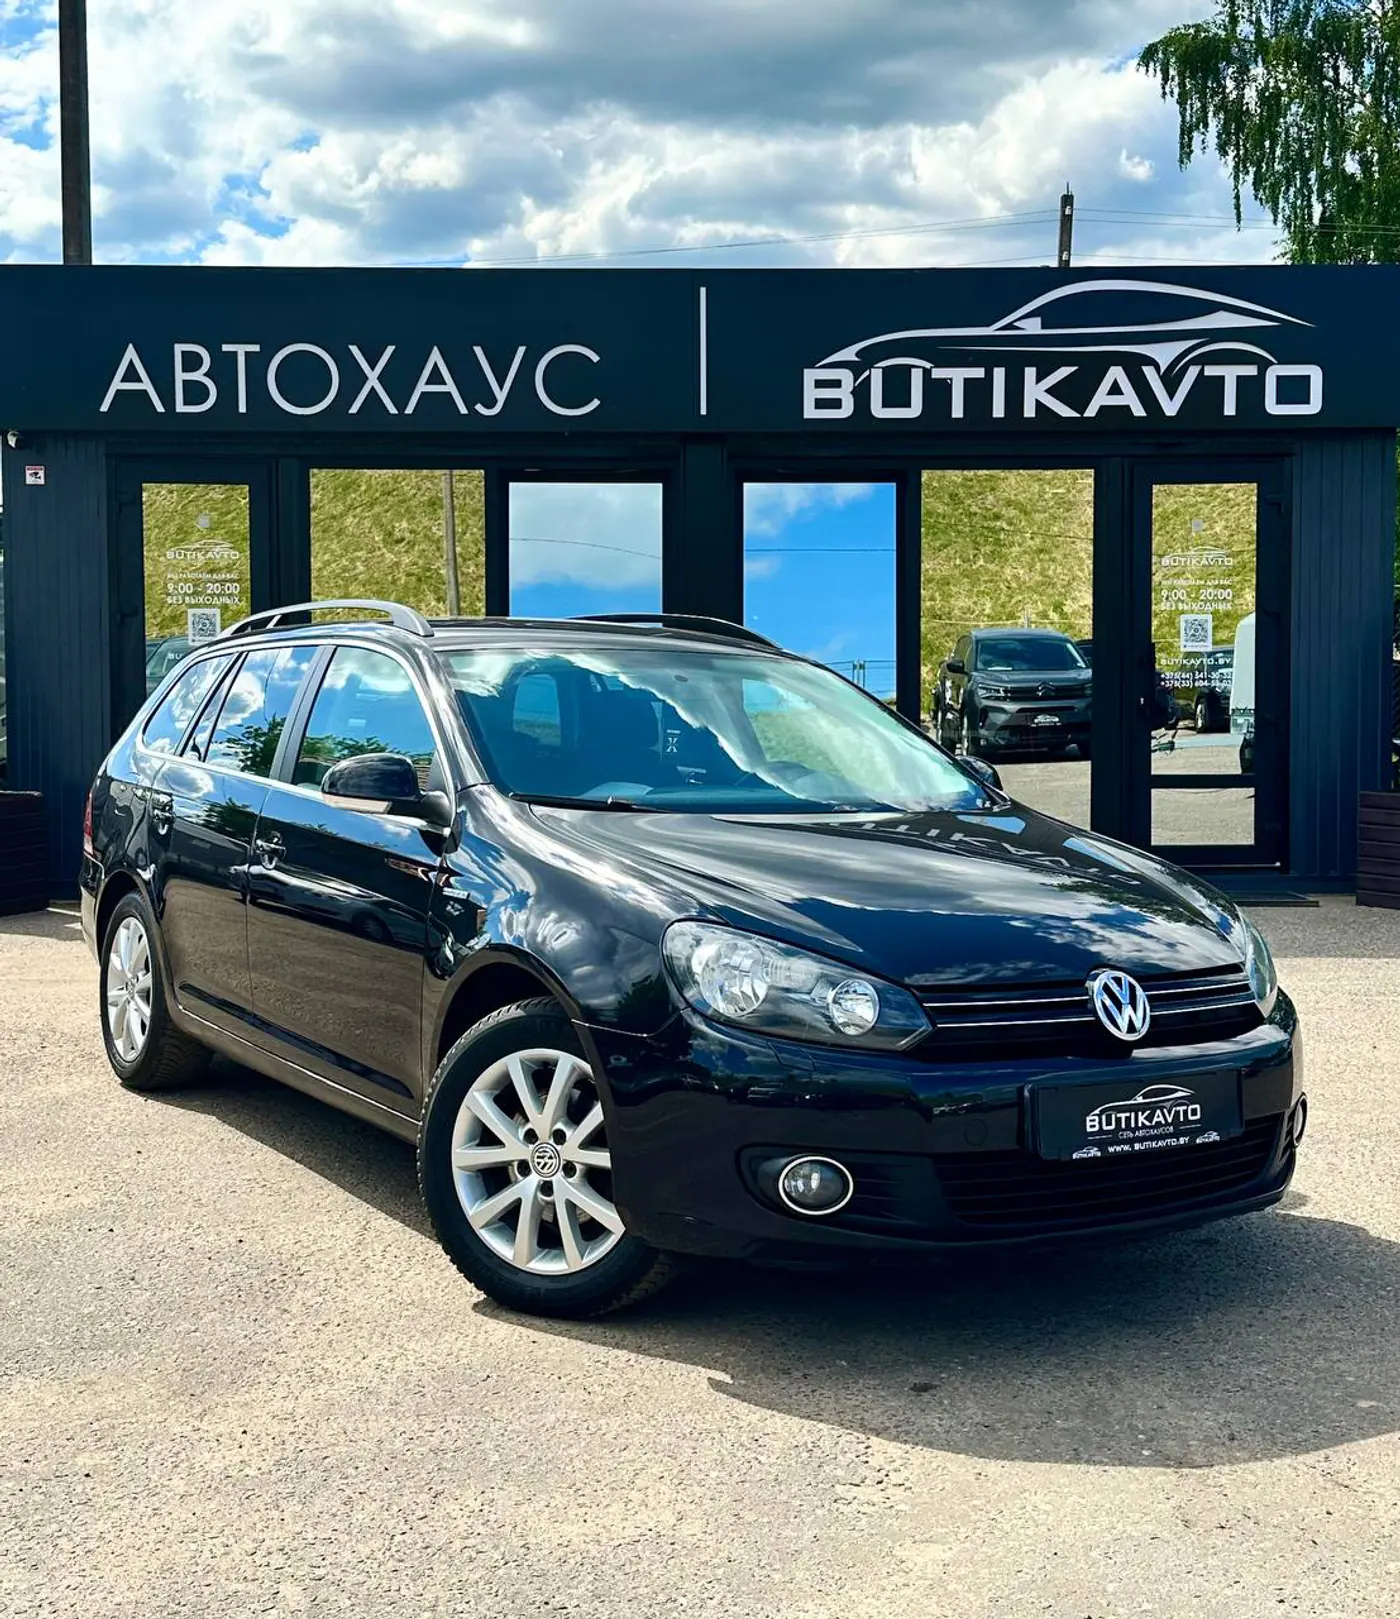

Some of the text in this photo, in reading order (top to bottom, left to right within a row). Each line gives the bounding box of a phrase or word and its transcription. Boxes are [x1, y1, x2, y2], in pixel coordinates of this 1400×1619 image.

[99, 342, 601, 416] АВТОХАУС
[803, 364, 1323, 419] BUTIKAVTO
[166, 551, 240, 559] BUTIKAVTO
[1161, 557, 1233, 566] BUTIKAVTO
[167, 583, 194, 594] 9:00
[206, 583, 240, 594] 20:00
[1161, 589, 1187, 600] 9:00
[1200, 589, 1233, 600] 20:00
[185, 595, 240, 605] ВЫХОДНЫХ
[1179, 602, 1233, 611] ВЫХОДНЫХ
[1086, 1104, 1201, 1132] BUTIKAVTO
[1118, 1131, 1134, 1139] СЕТЬ
